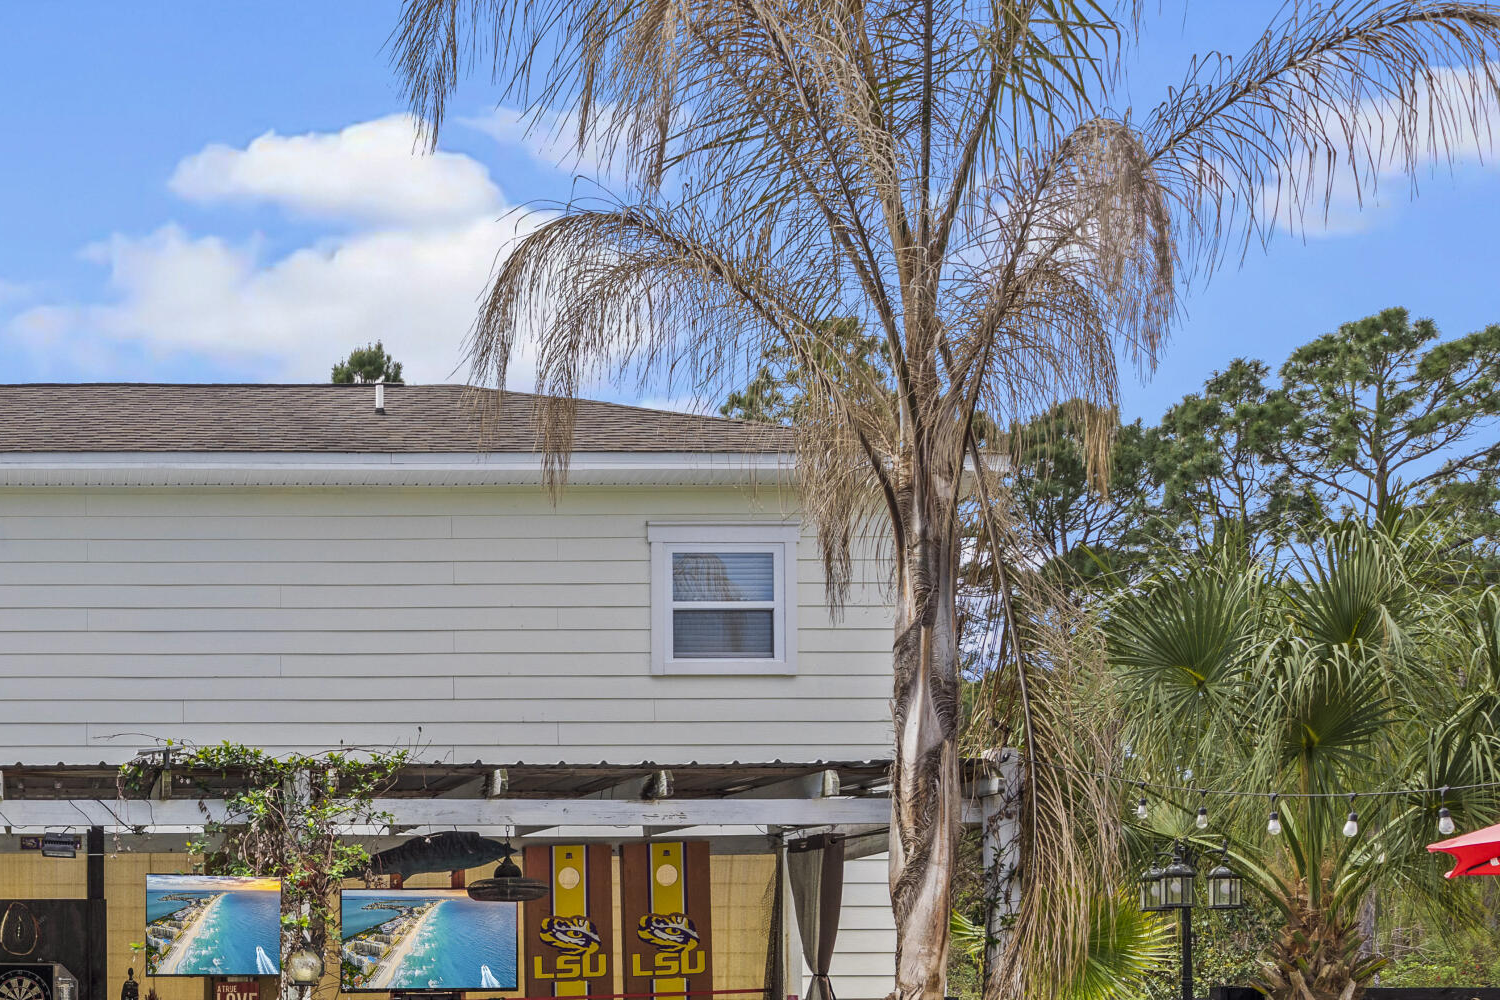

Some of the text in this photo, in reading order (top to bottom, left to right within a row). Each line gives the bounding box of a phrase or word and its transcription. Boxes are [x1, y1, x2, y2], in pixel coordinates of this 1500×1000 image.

[534, 954, 607, 979] LSU
[632, 951, 706, 977] LSU
[217, 985, 237, 993] A TRUE
